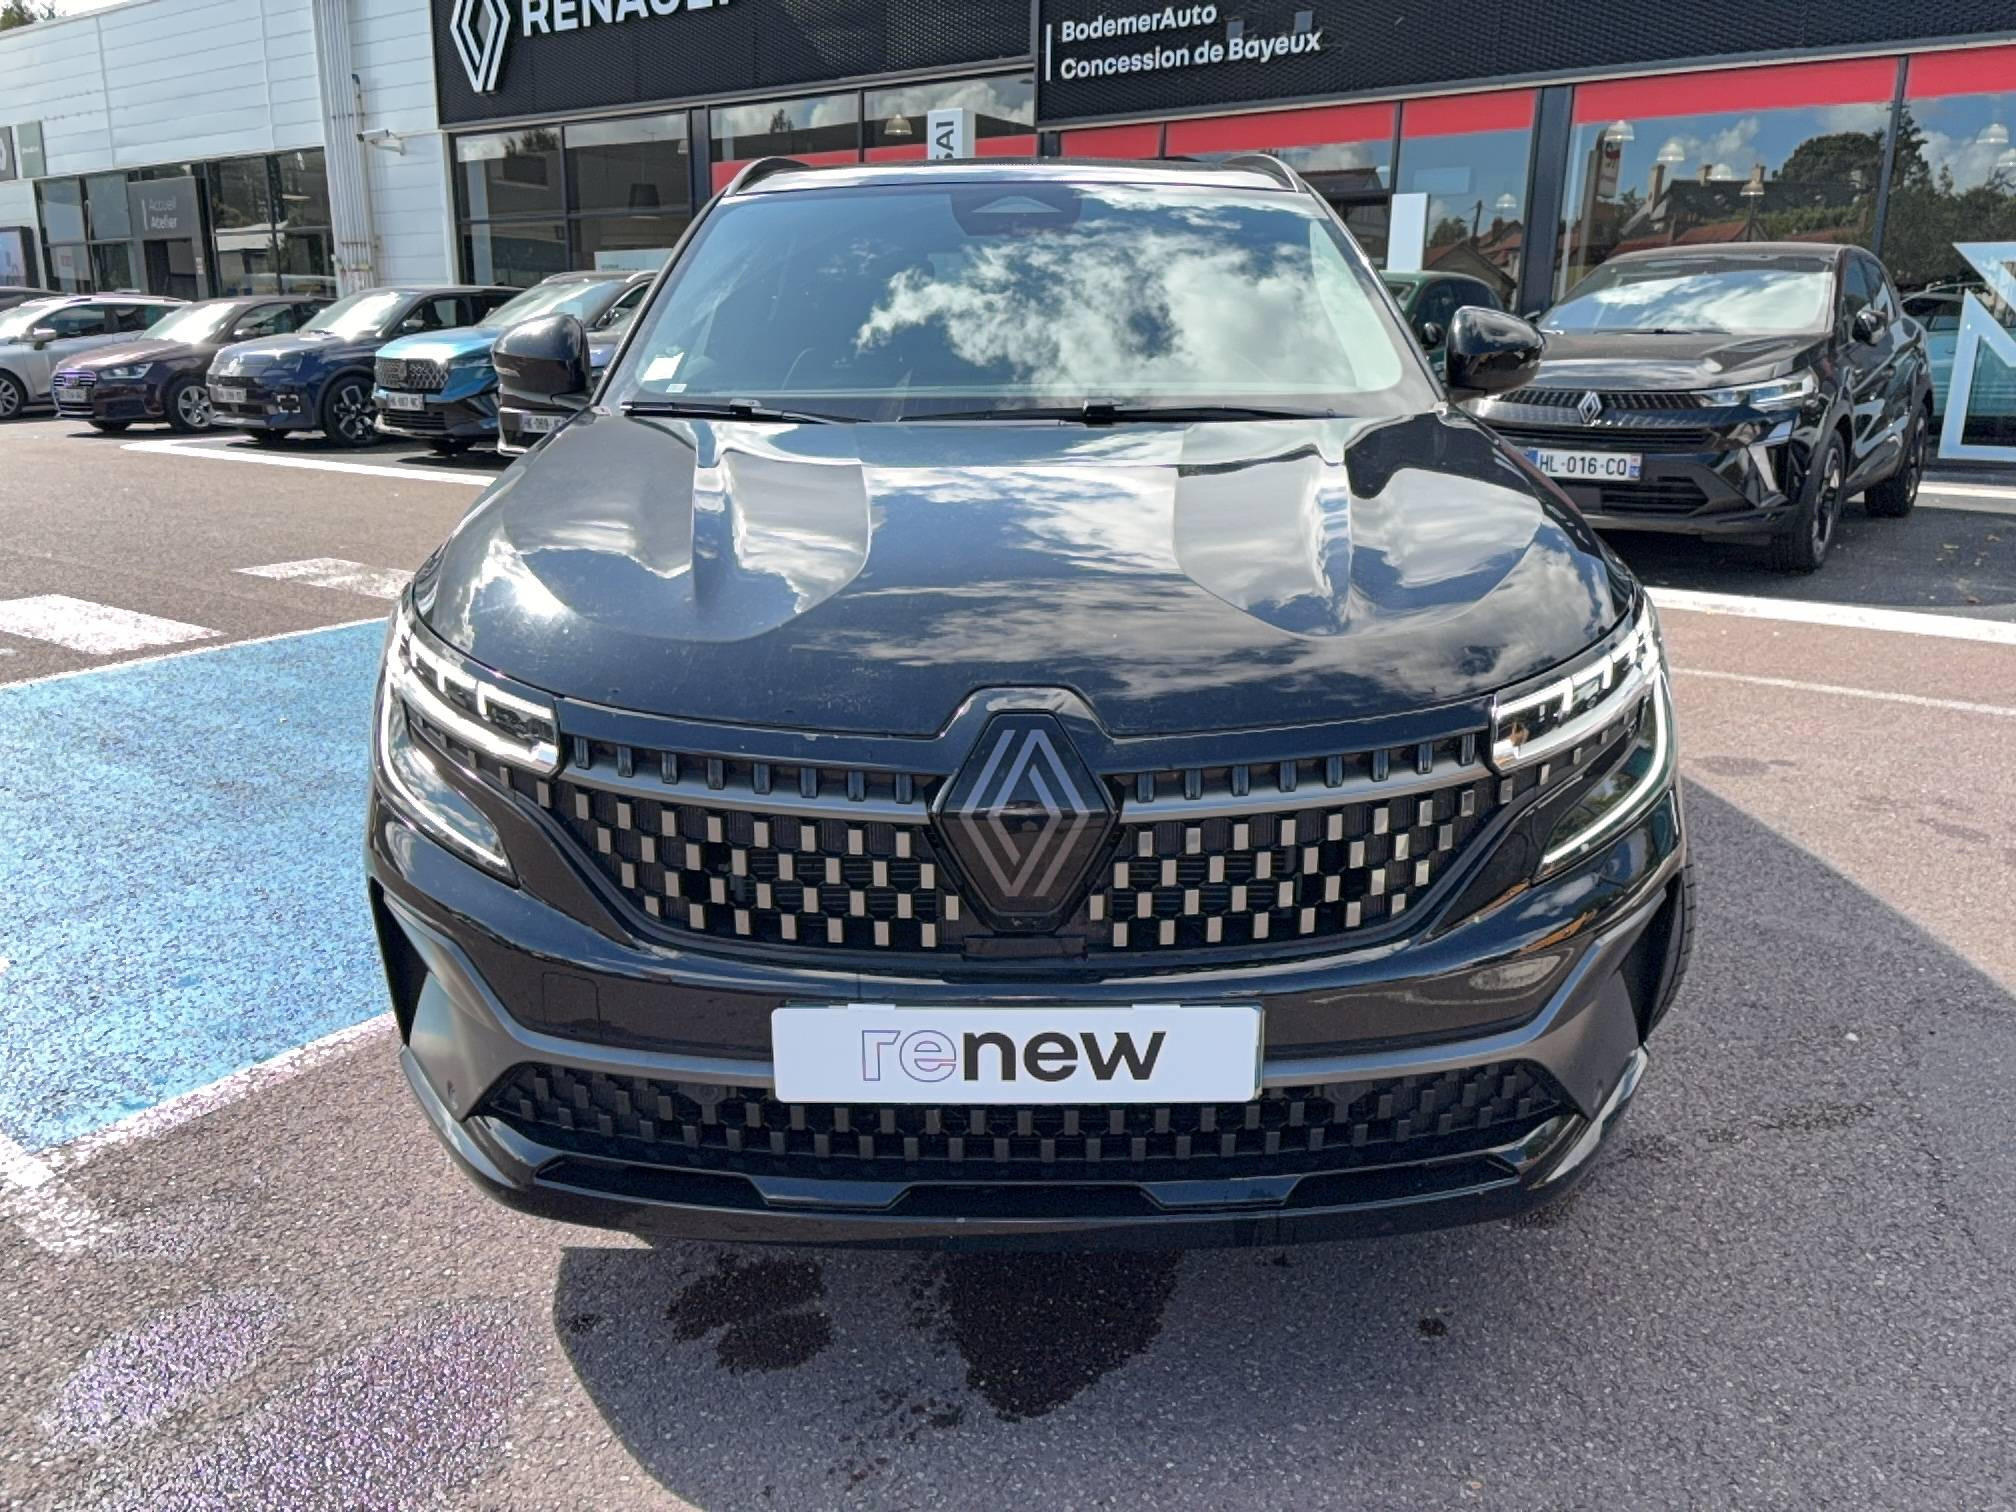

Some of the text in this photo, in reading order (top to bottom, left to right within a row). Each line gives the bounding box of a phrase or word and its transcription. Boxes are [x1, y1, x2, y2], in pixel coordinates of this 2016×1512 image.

[1060, 5, 1218, 43] BodemerAuto
[1060, 29, 1322, 80] Concession de Bayeux
[860, 1029, 1167, 1083] renew
